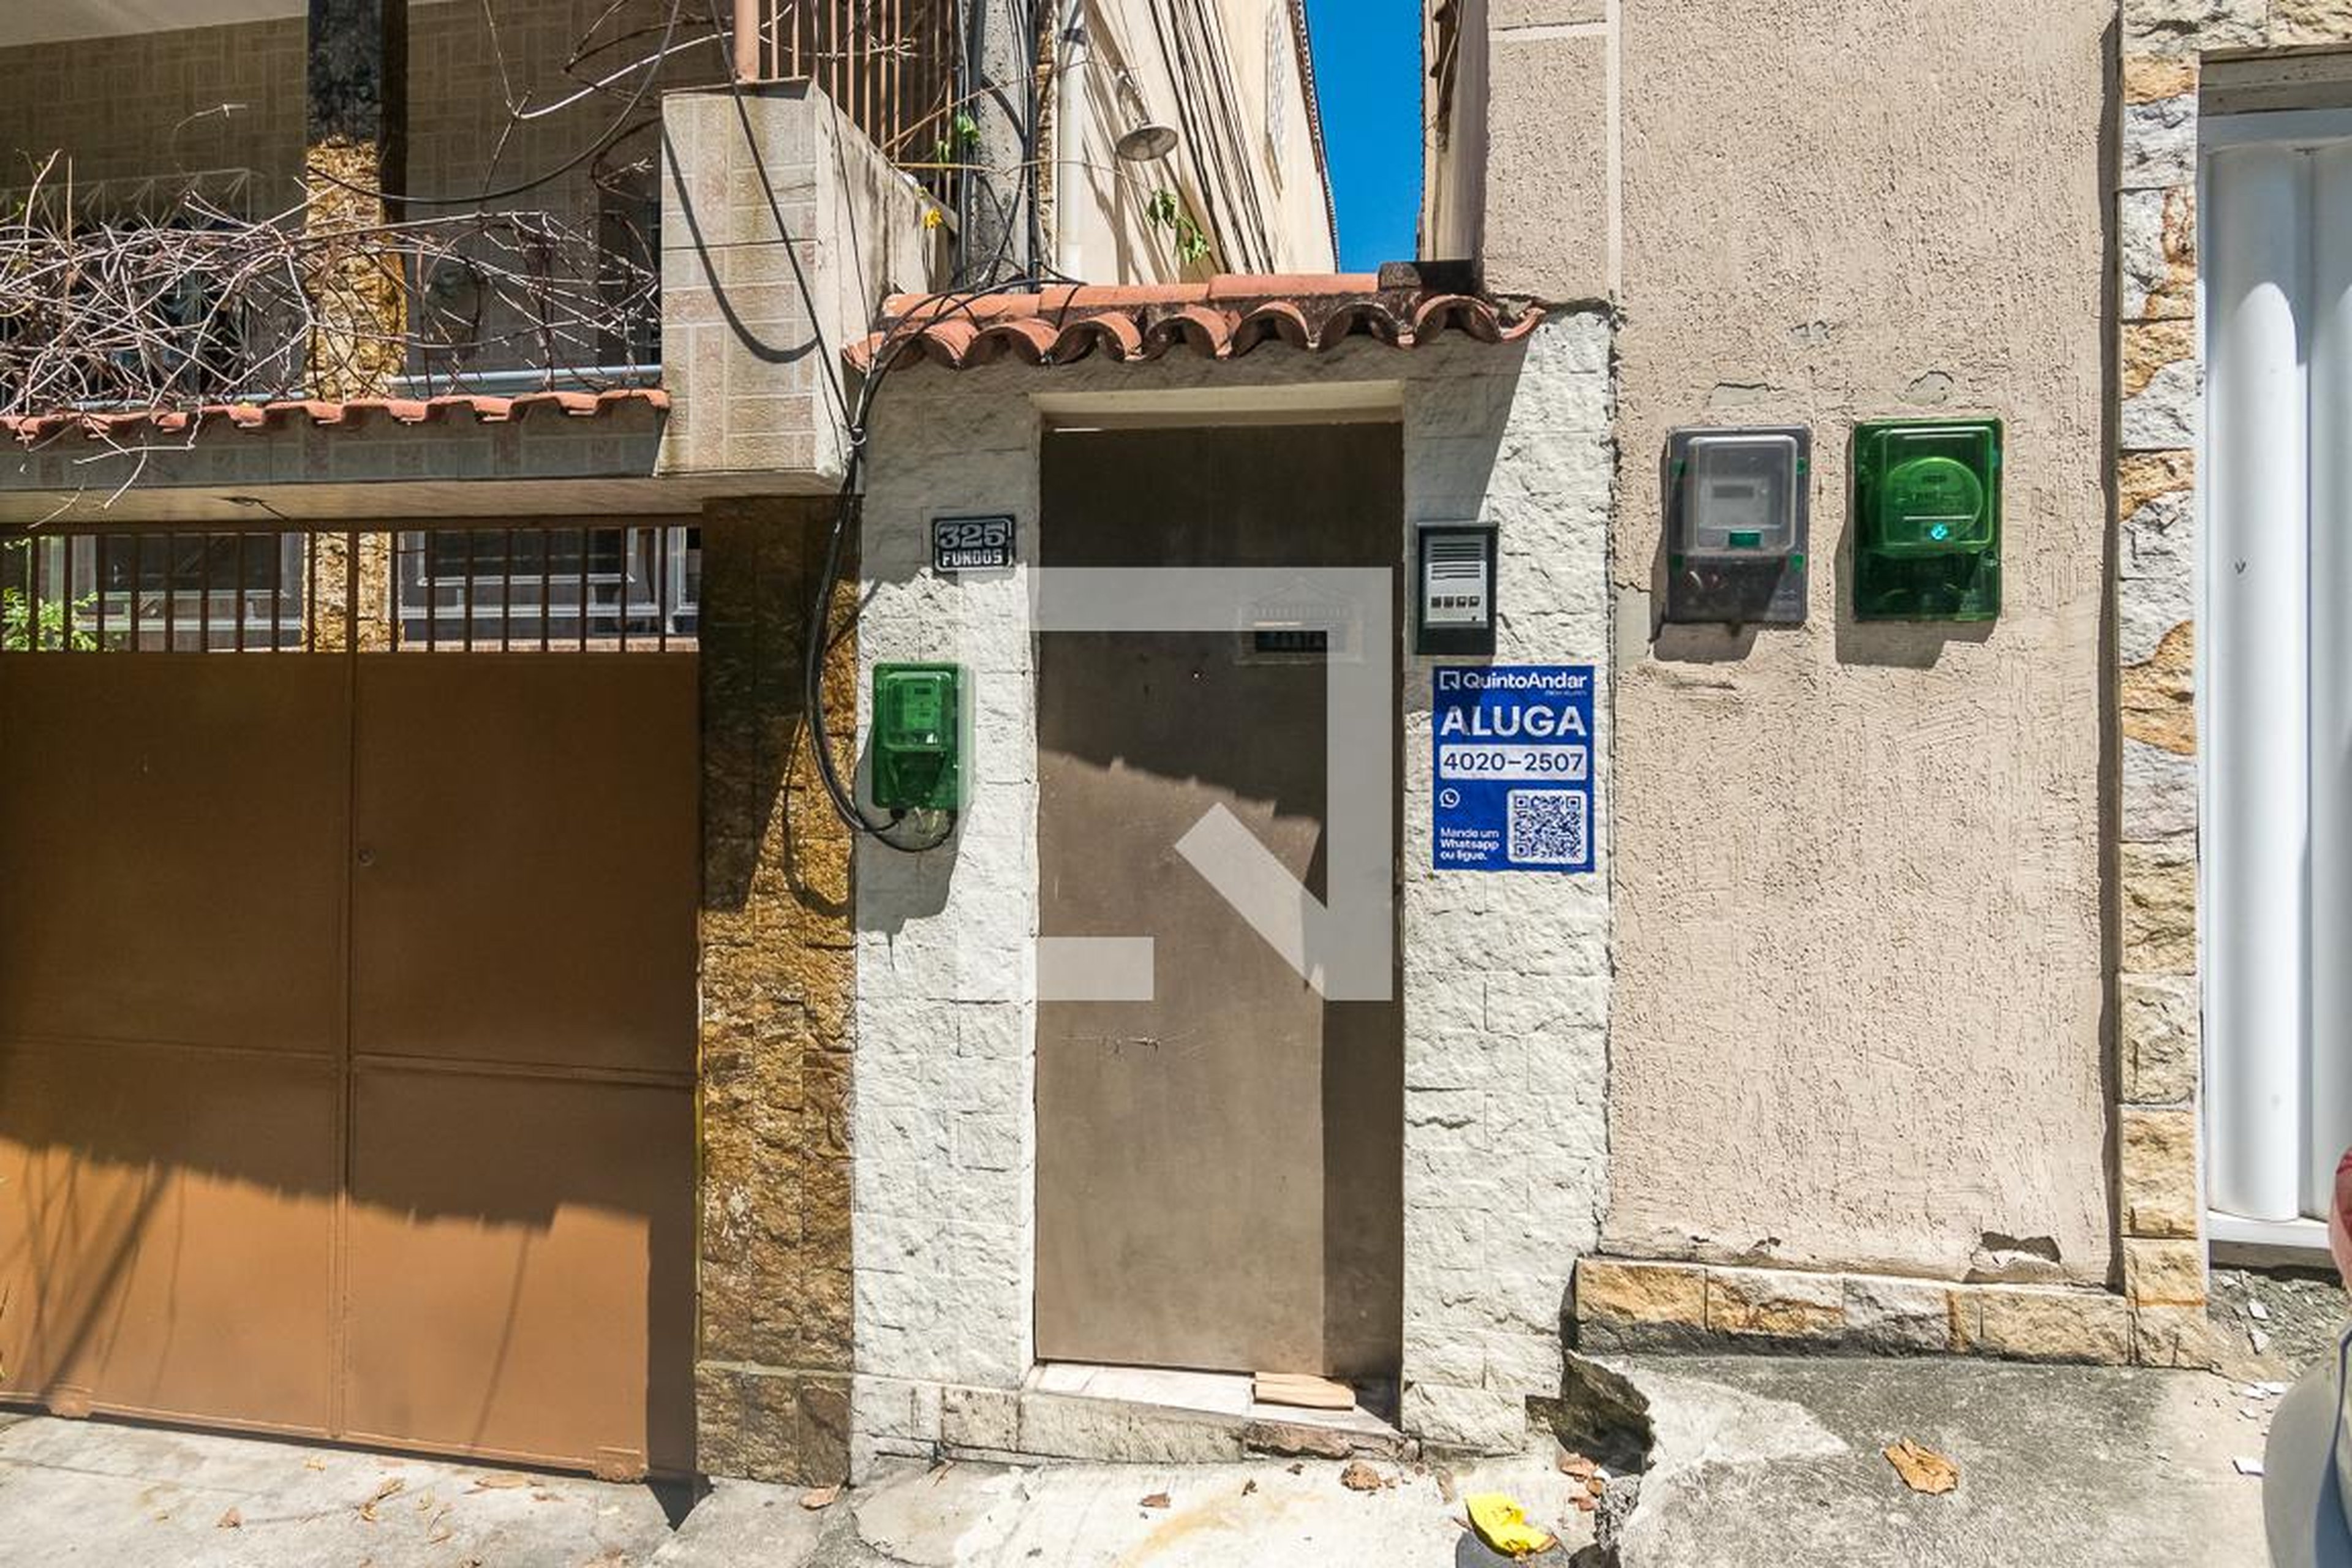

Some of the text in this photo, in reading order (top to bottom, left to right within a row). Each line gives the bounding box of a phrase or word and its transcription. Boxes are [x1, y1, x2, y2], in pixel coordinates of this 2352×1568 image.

[939, 522, 1006, 549] 325
[942, 549, 1003, 567] FUNDOS
[1463, 672, 1588, 689] QuintoAndar
[1441, 706, 1587, 736] ALUGA
[1444, 753, 1584, 771] 4020-2507
[1441, 827, 1499, 839] Mande um
[1441, 851, 1454, 860] ou
